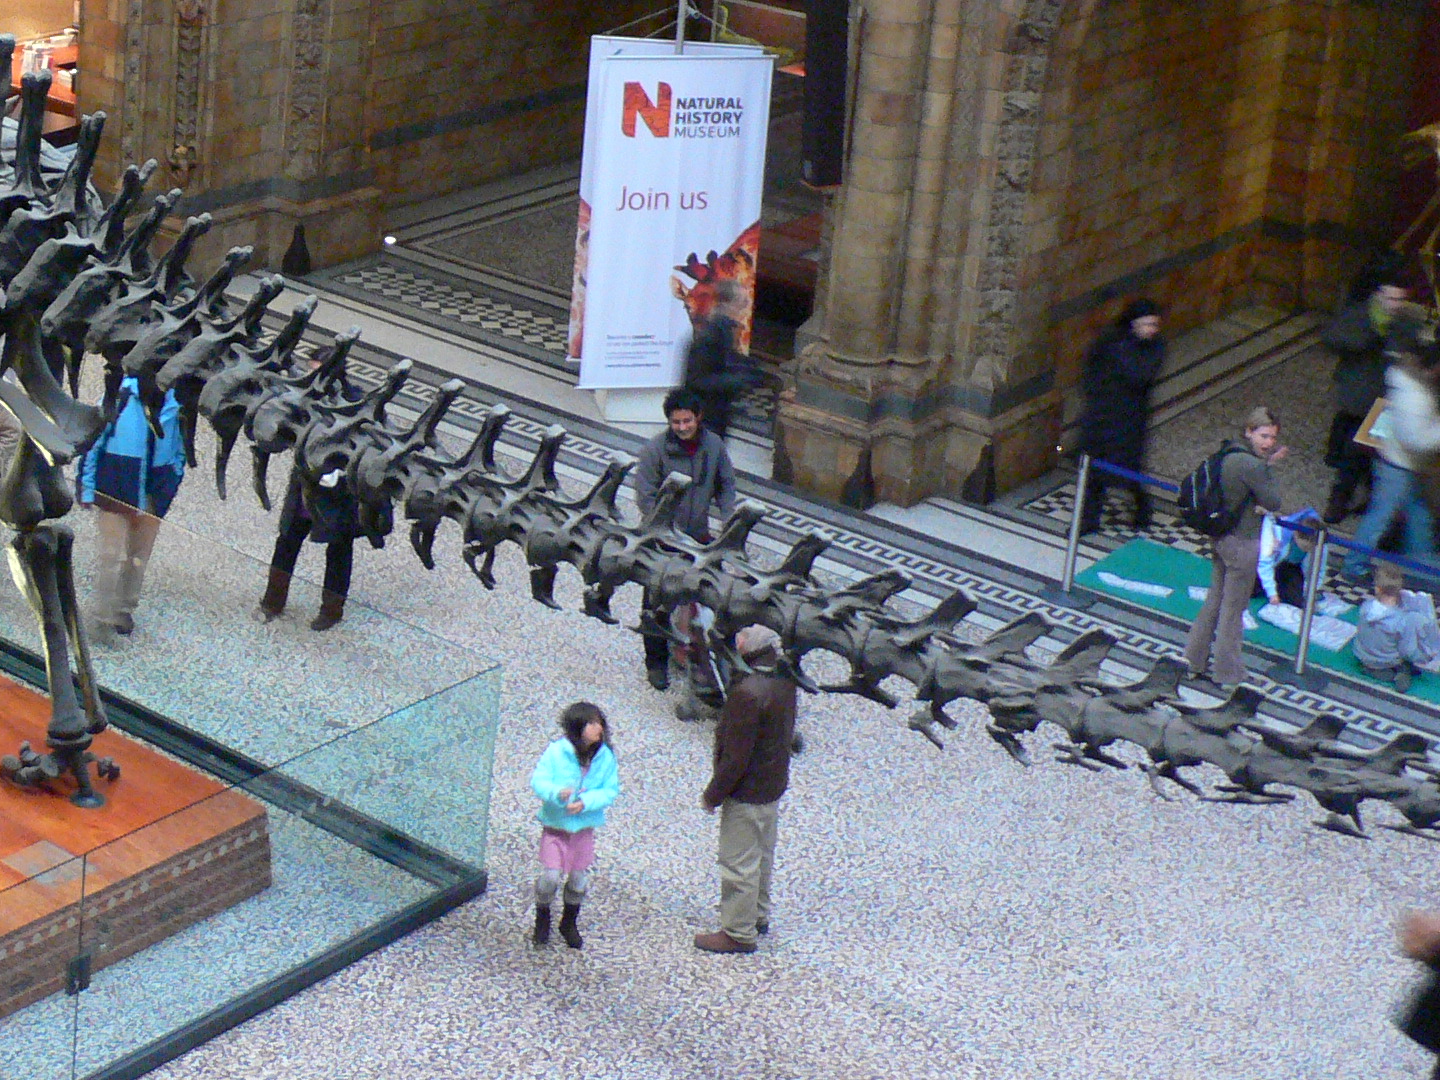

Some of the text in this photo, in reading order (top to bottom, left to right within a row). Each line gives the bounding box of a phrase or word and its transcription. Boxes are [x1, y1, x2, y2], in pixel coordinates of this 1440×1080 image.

[622, 81, 671, 138] N
[676, 97, 743, 110] NATURAL
[675, 111, 742, 125] HISTORY
[674, 126, 740, 138] MUSEUM
[617, 185, 708, 211] Join us
